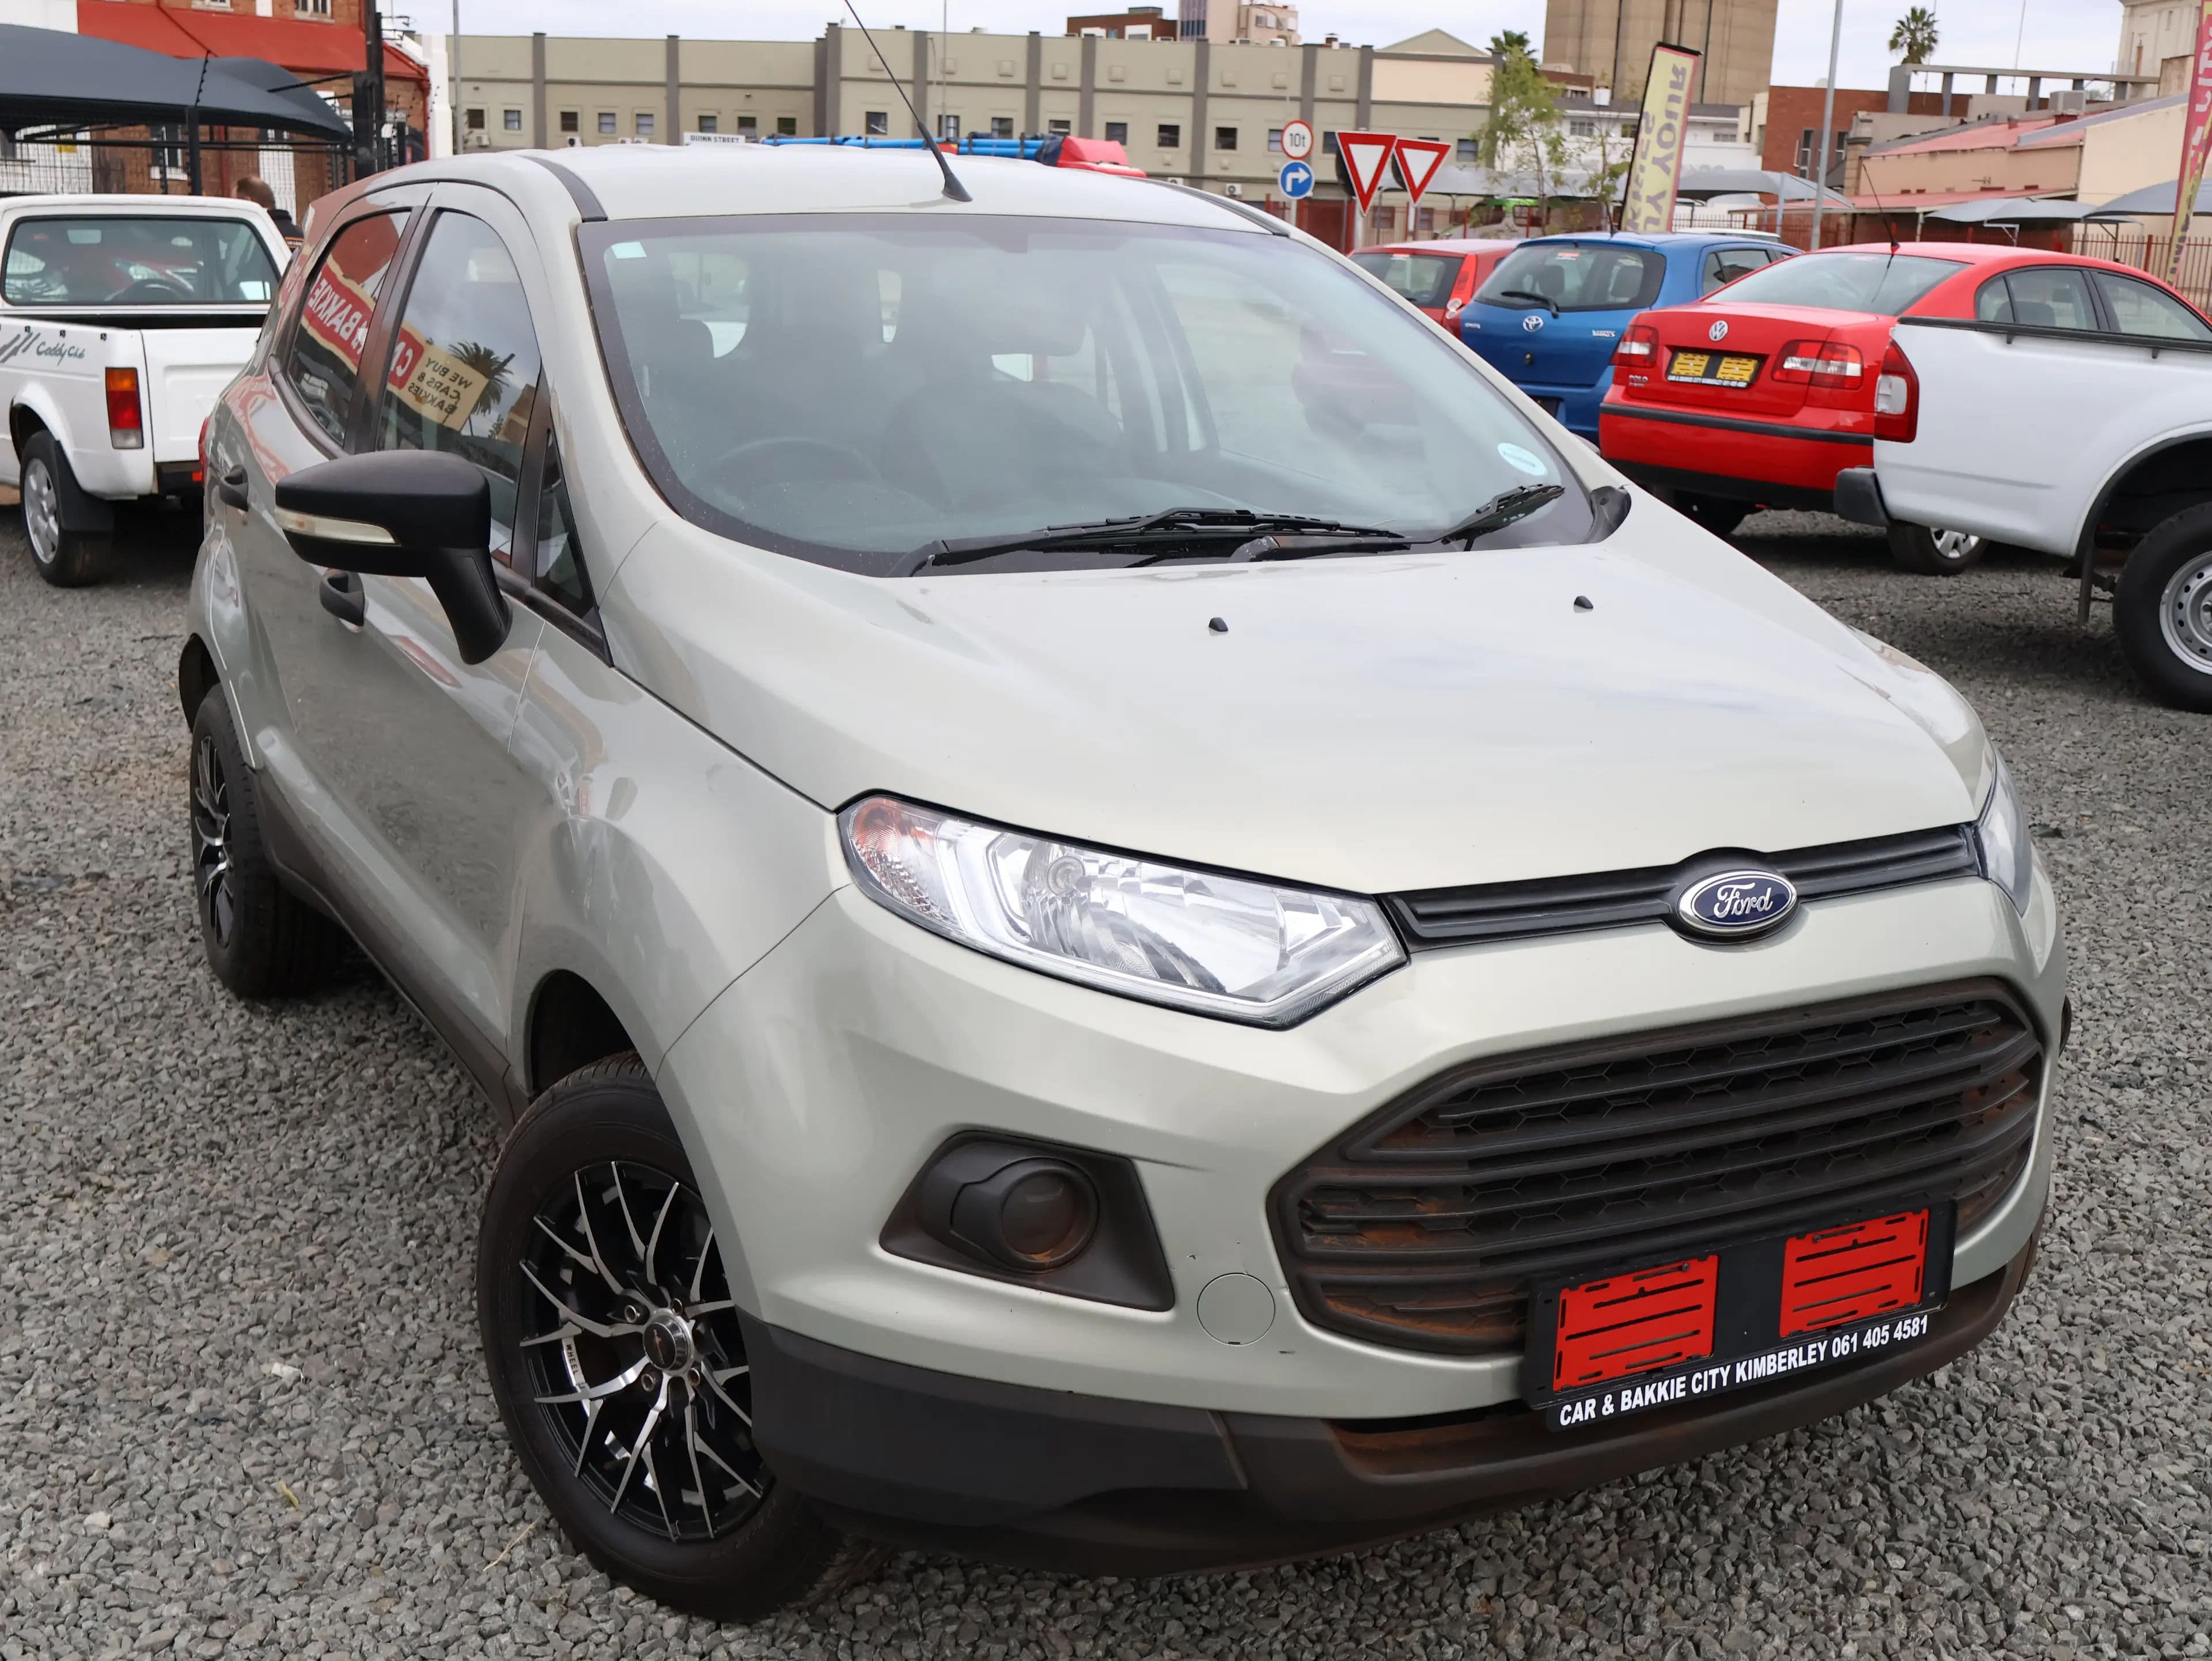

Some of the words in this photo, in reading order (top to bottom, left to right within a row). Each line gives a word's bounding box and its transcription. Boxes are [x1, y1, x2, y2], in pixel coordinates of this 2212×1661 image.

[1290, 133, 1306, 147] 10t
[1713, 883, 1773, 918] Ford
[566, 1344, 578, 1375] WHEEL
[1559, 1398, 1596, 1426] CAR
[1601, 1394, 1614, 1416] &
[1620, 1376, 1687, 1412] BAKKIE
[1691, 1365, 1730, 1394] CITY
[1736, 1340, 1828, 1383] KIMBERLEY
[1832, 1332, 1858, 1358] 061
[1863, 1325, 1889, 1349] 405
[1893, 1315, 1928, 1341] 4581
